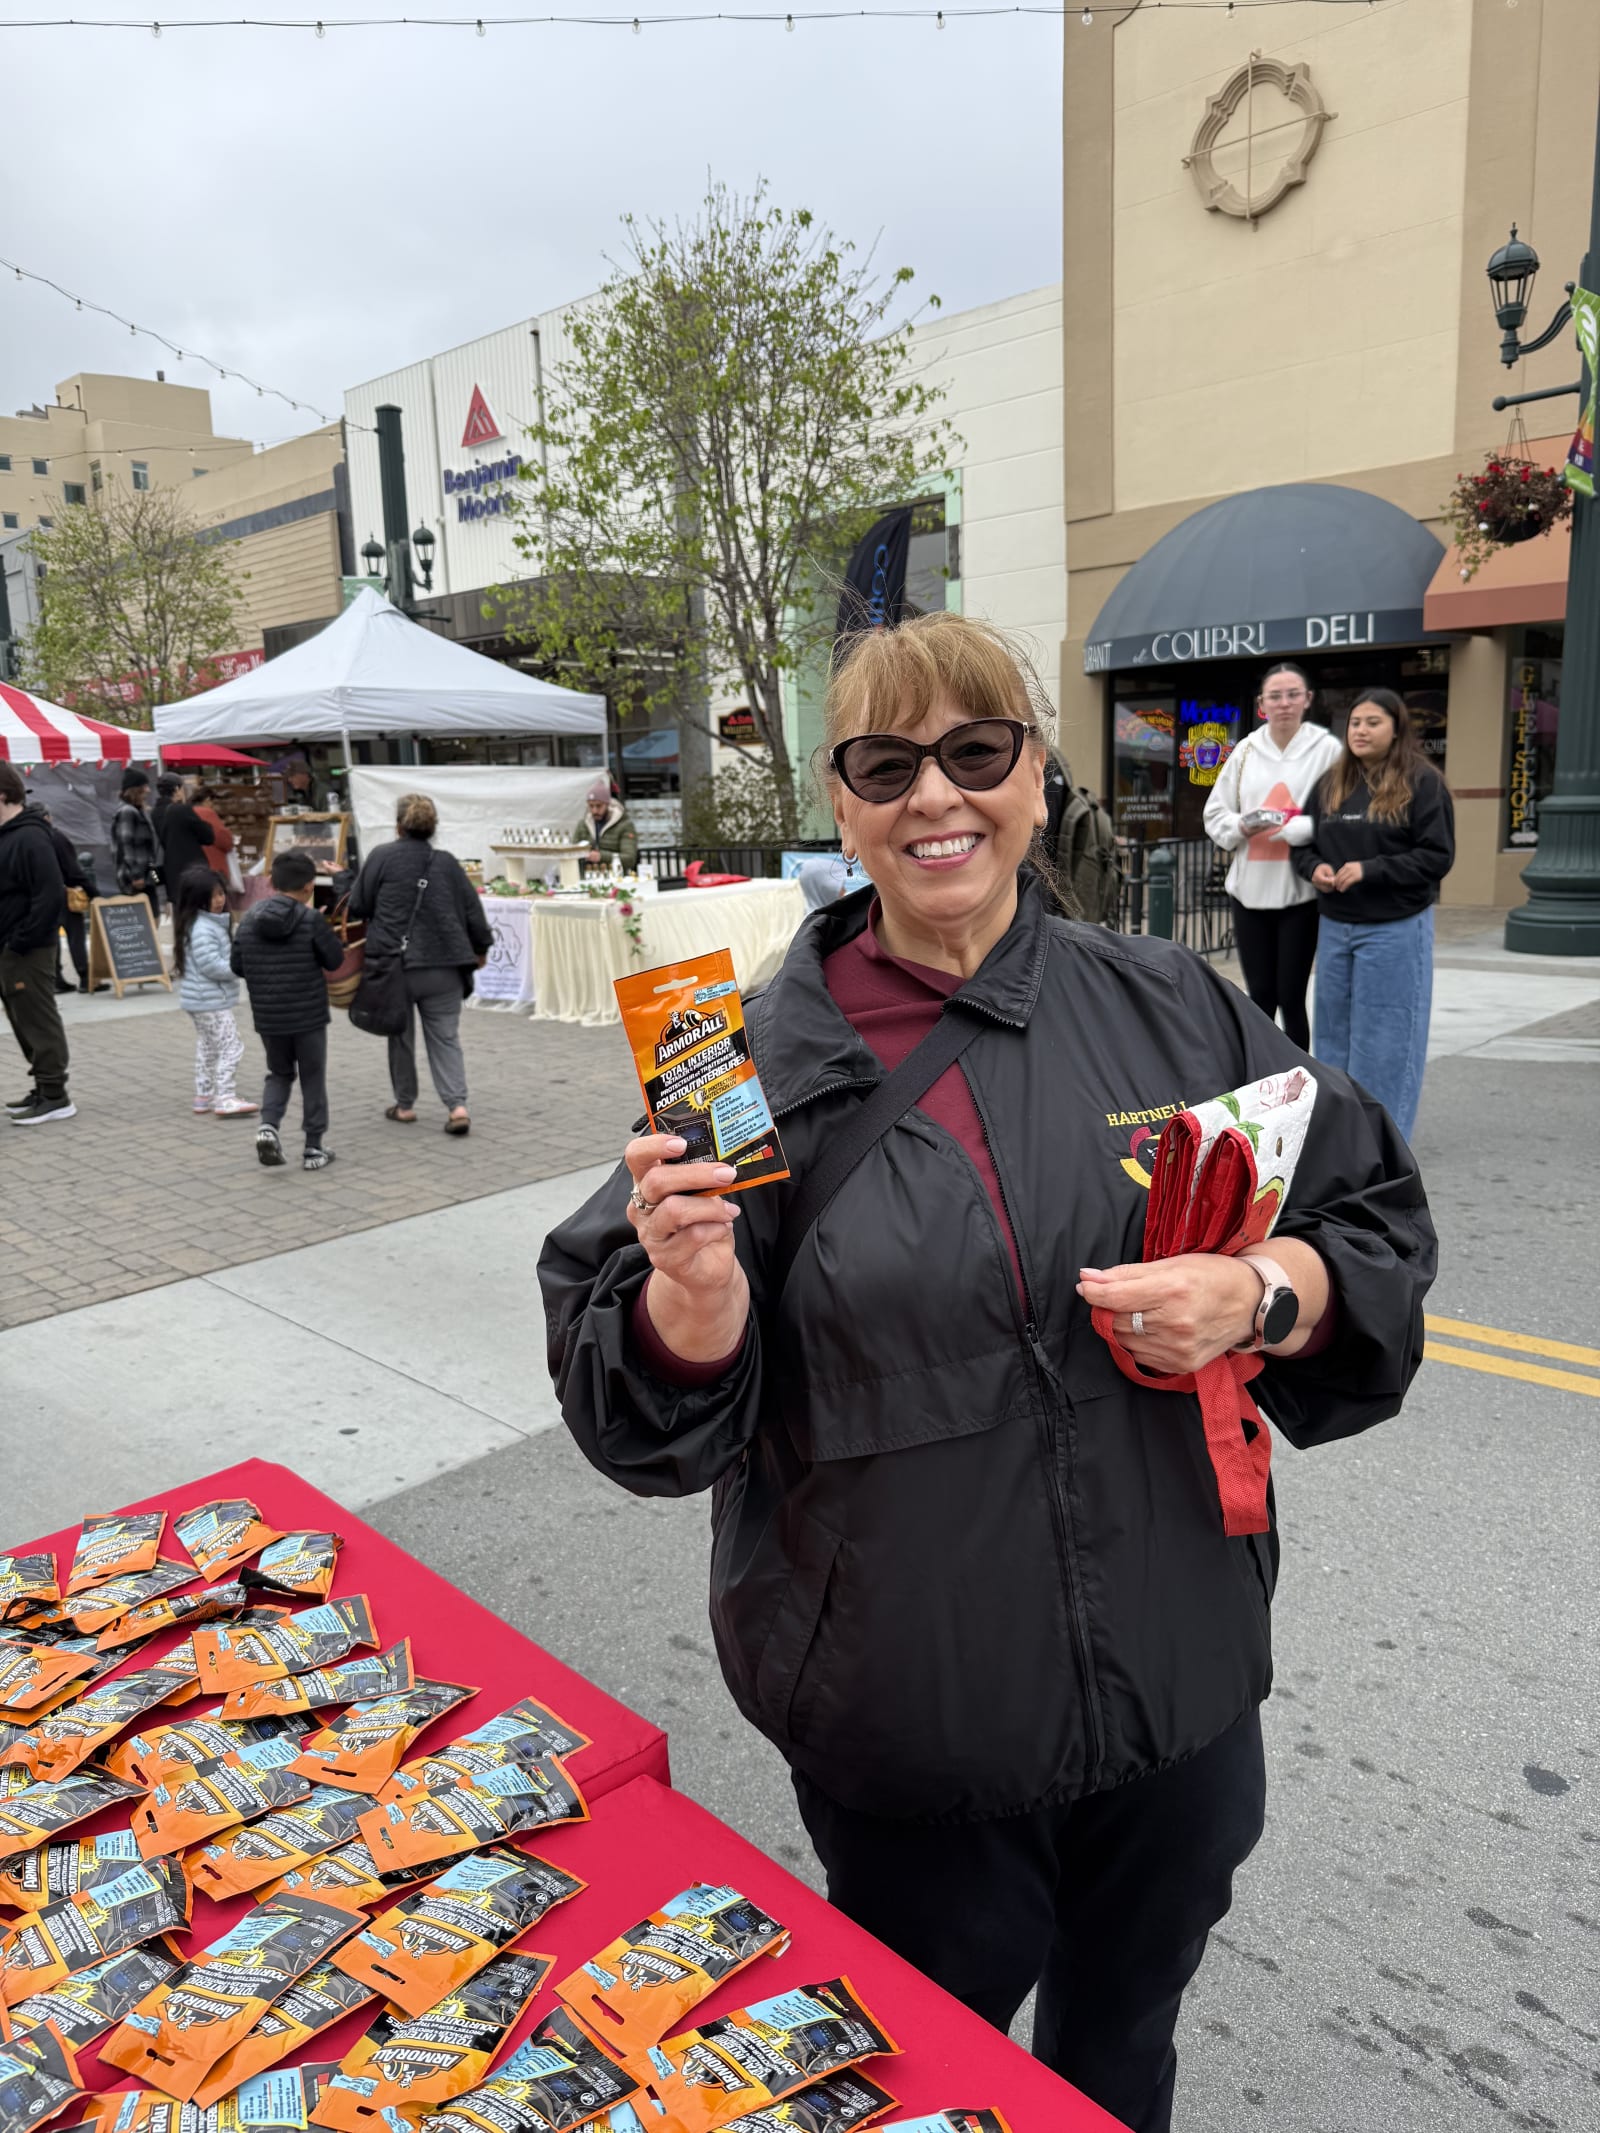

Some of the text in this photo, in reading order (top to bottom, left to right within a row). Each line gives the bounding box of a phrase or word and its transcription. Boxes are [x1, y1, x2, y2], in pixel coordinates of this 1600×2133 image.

[443, 449, 523, 495] Benjamin
[1151, 622, 1268, 662] COLIBRI
[1306, 613, 1375, 648] DELI
[1179, 699, 1241, 724] Modelo
[1510, 751, 1529, 828] SHOP
[660, 1036, 731, 1082] TOTAL INTERIOR
[693, 1046, 729, 1070] PROTECTANT
[660, 1073, 695, 1097] PROTECTEUR
[700, 1049, 737, 1074] TRAITEMENT
[1105, 1101, 1187, 1126] HARTNELL
[456, 1919, 487, 1936] TOTAL
[54, 1936, 71, 1956] TOTAL
[675, 1947, 705, 1966] TOTAL
[224, 1986, 256, 1999] TOTAL
[434, 2033, 473, 2046] TOTAL
[739, 2056, 767, 2079] TOTAL
[485, 2111, 515, 2132] TOTAL
